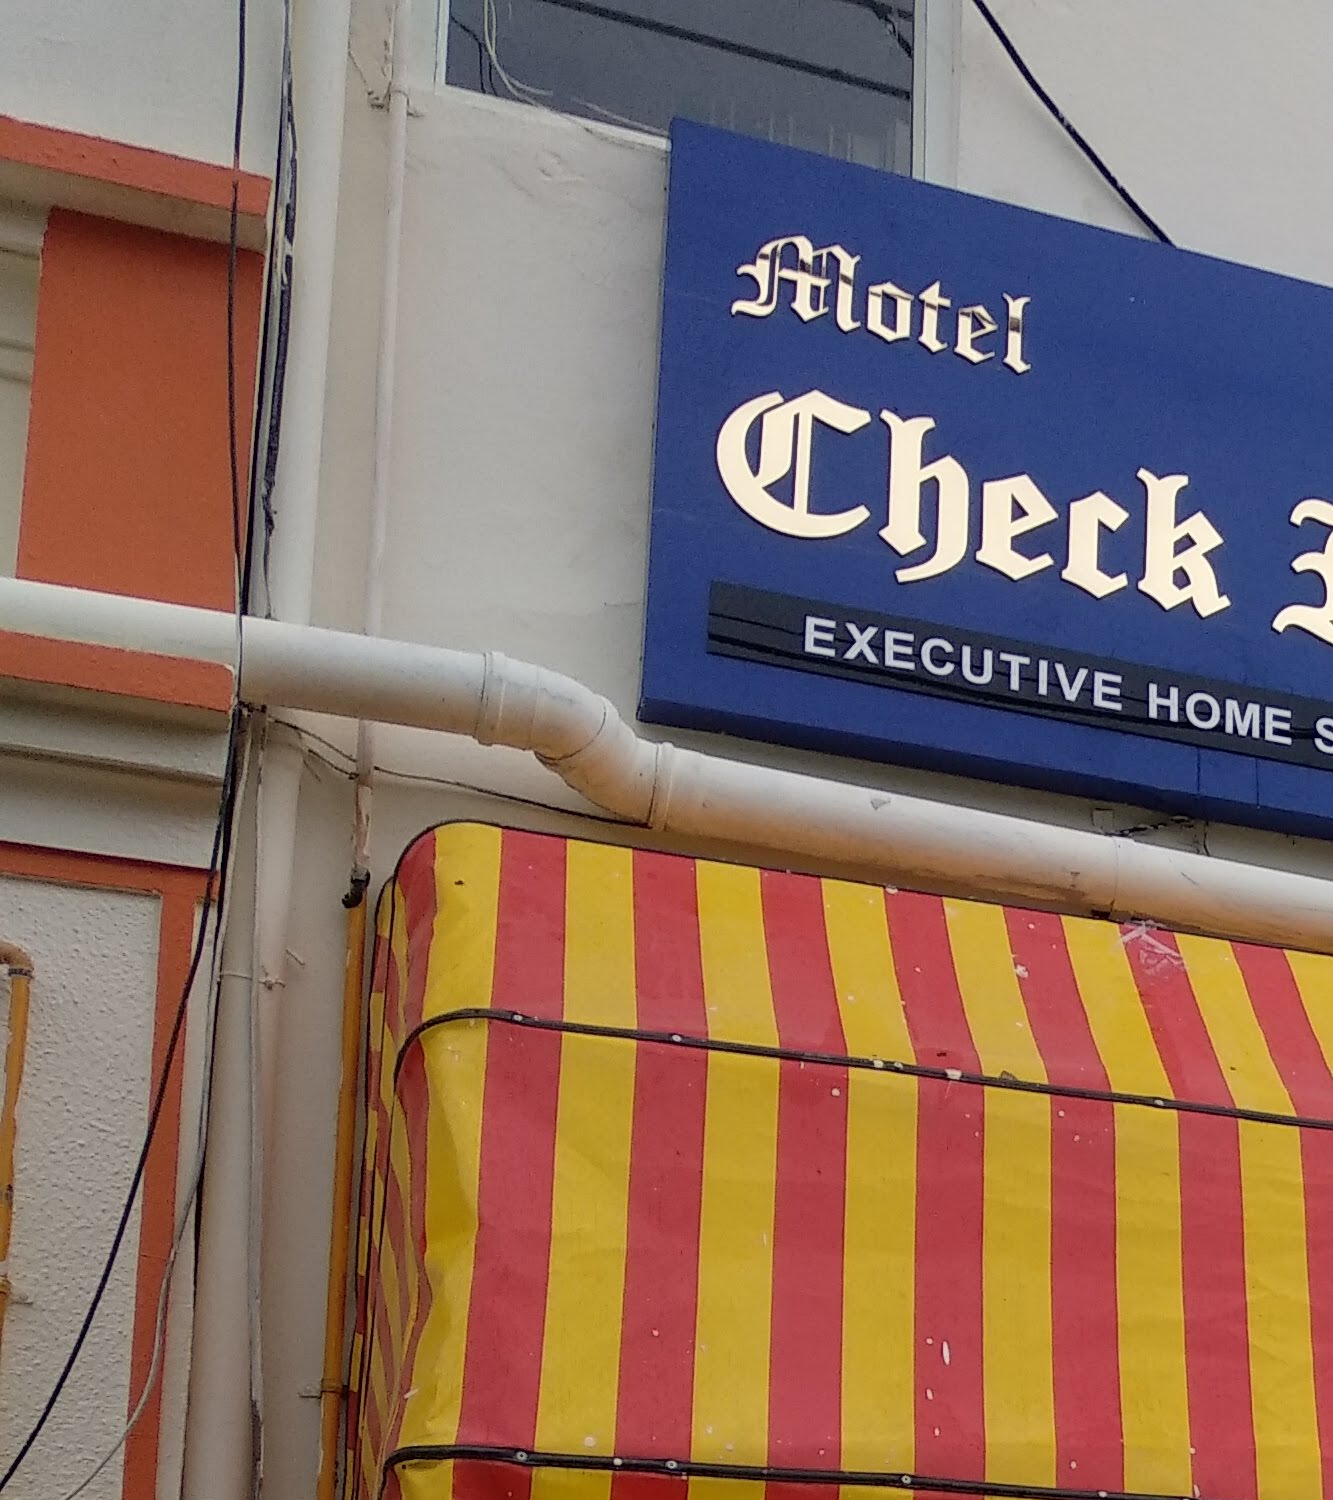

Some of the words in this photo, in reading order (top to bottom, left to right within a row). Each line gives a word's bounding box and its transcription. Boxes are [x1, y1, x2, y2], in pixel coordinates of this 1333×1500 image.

[730, 234, 1032, 376] Motel
[715, 388, 1232, 620] Check
[803, 614, 1123, 712] EXECUTIVE
[1146, 682, 1294, 748] HOME
